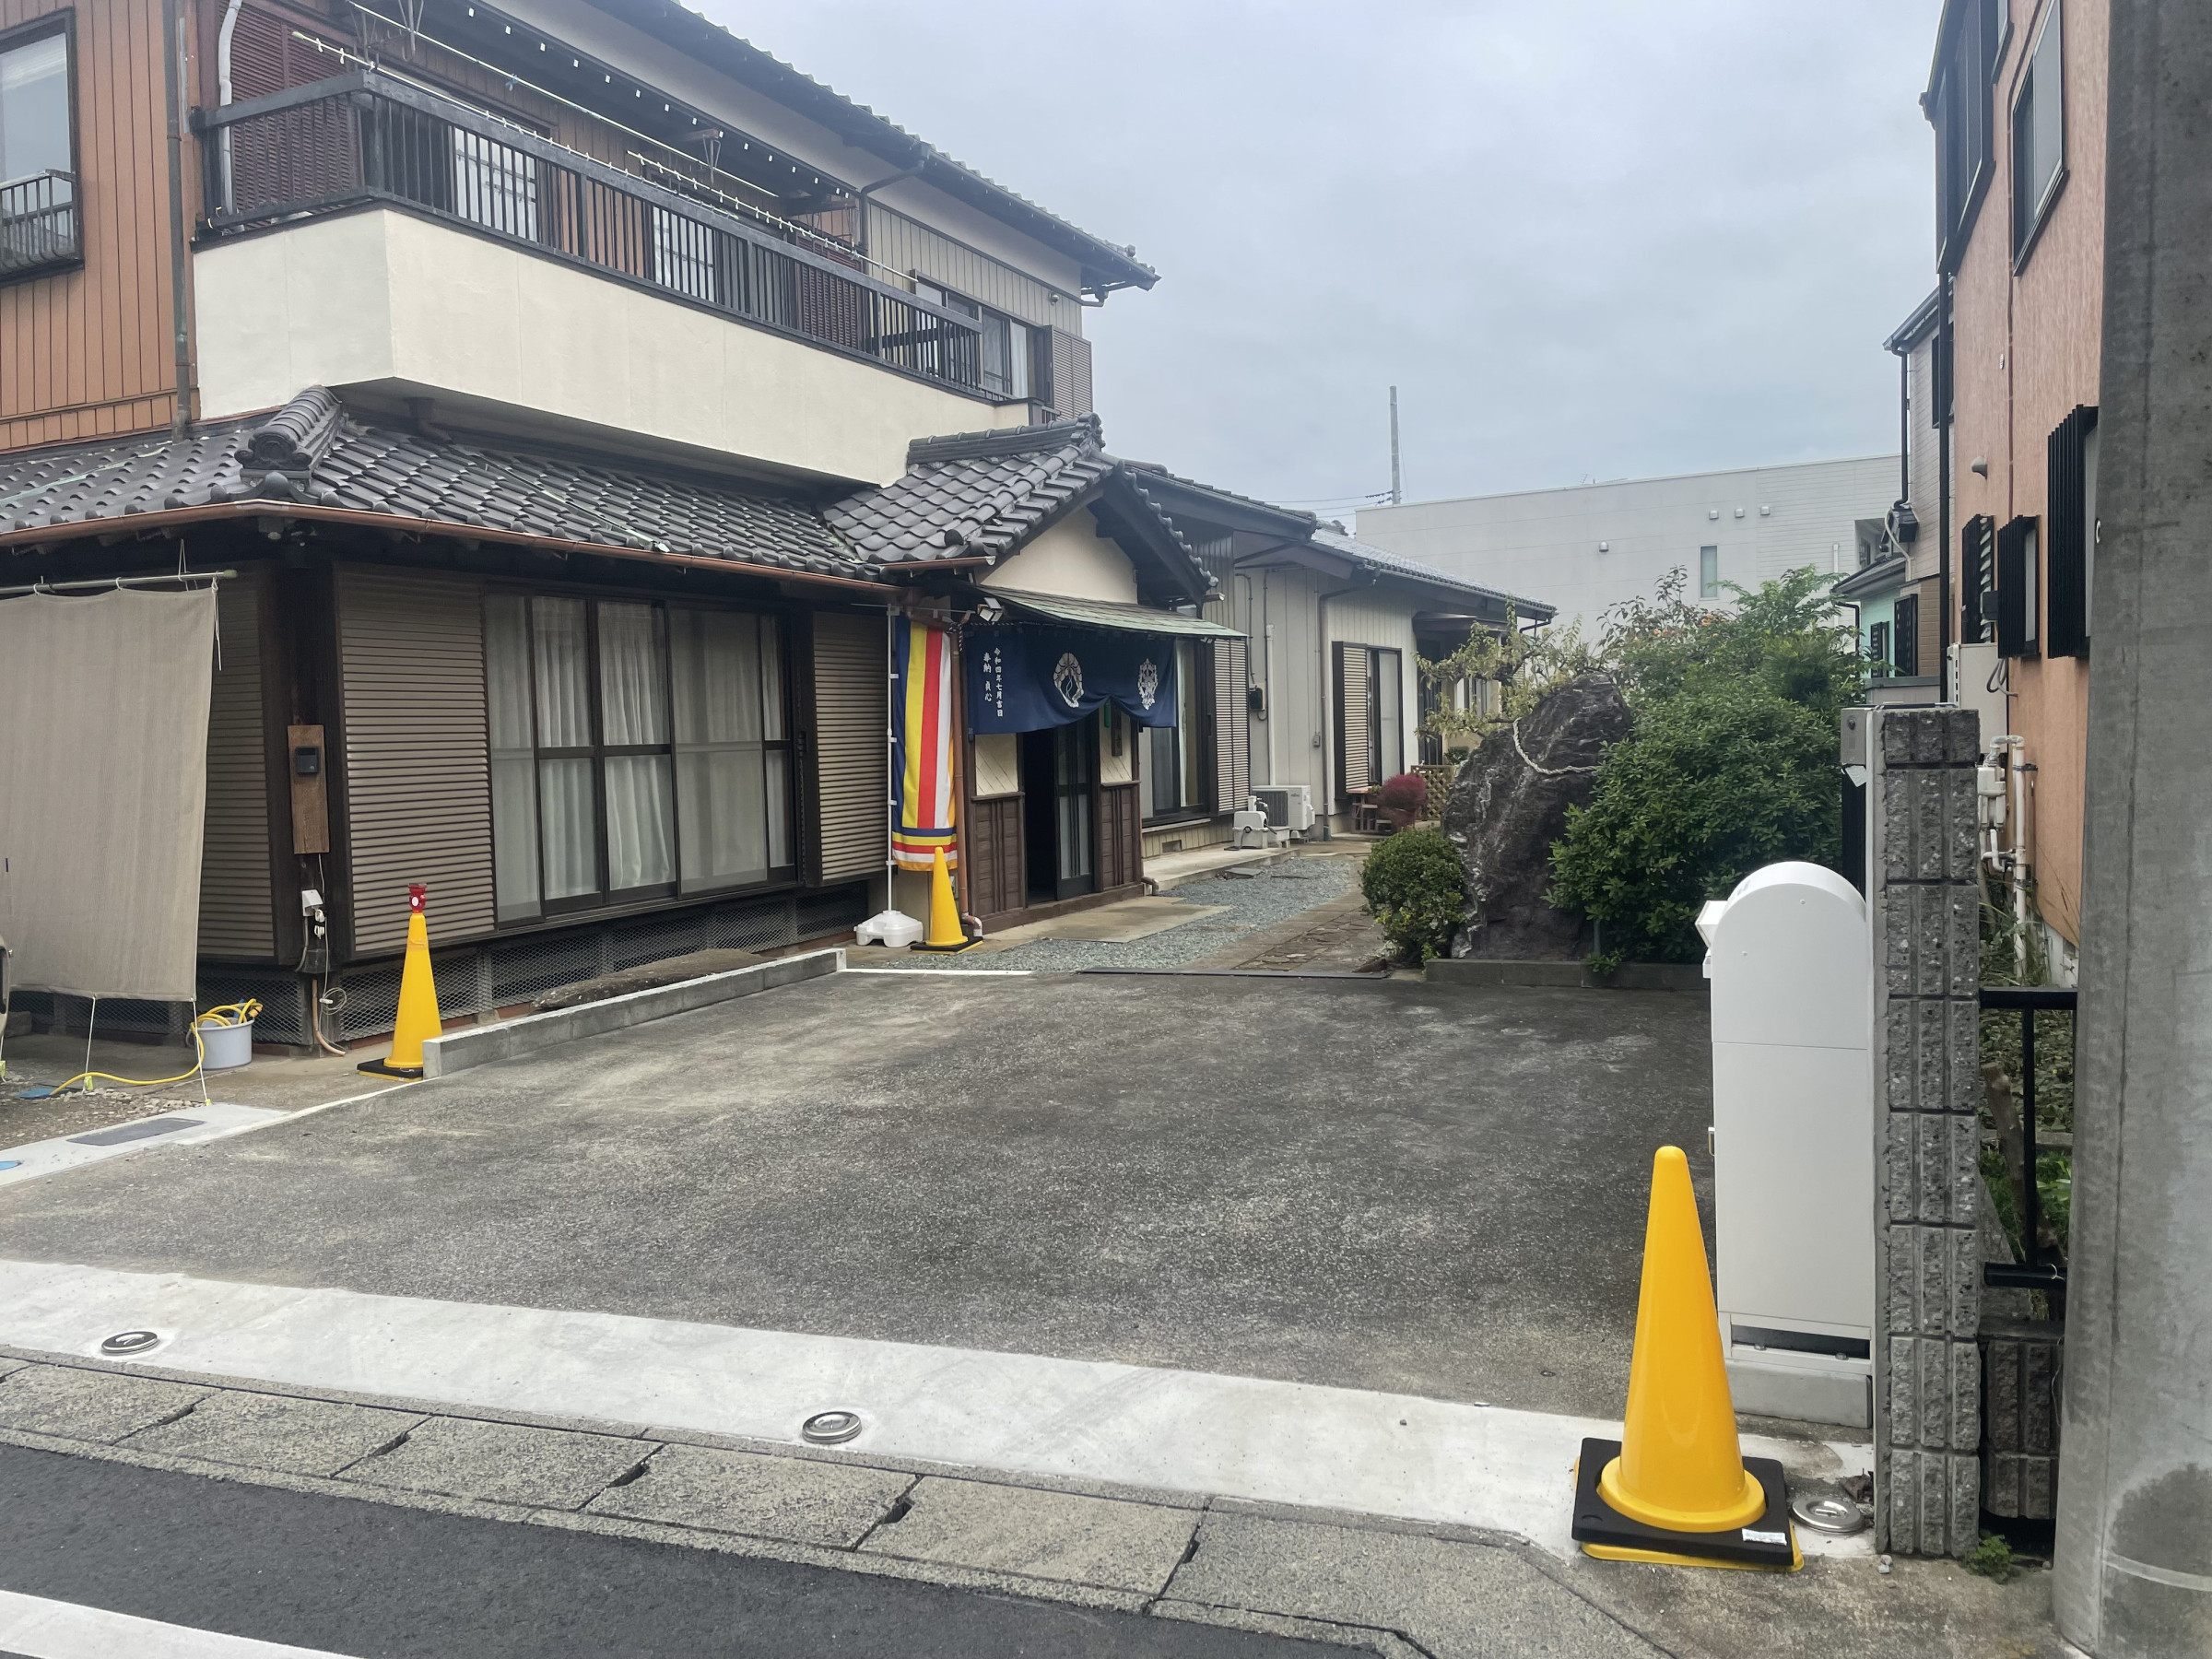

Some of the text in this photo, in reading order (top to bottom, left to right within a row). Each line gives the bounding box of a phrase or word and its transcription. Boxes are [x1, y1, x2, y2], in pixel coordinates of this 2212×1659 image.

[983, 652, 992, 673] 奉納
[994, 647, 1003, 717] 令和四年七月吉日
